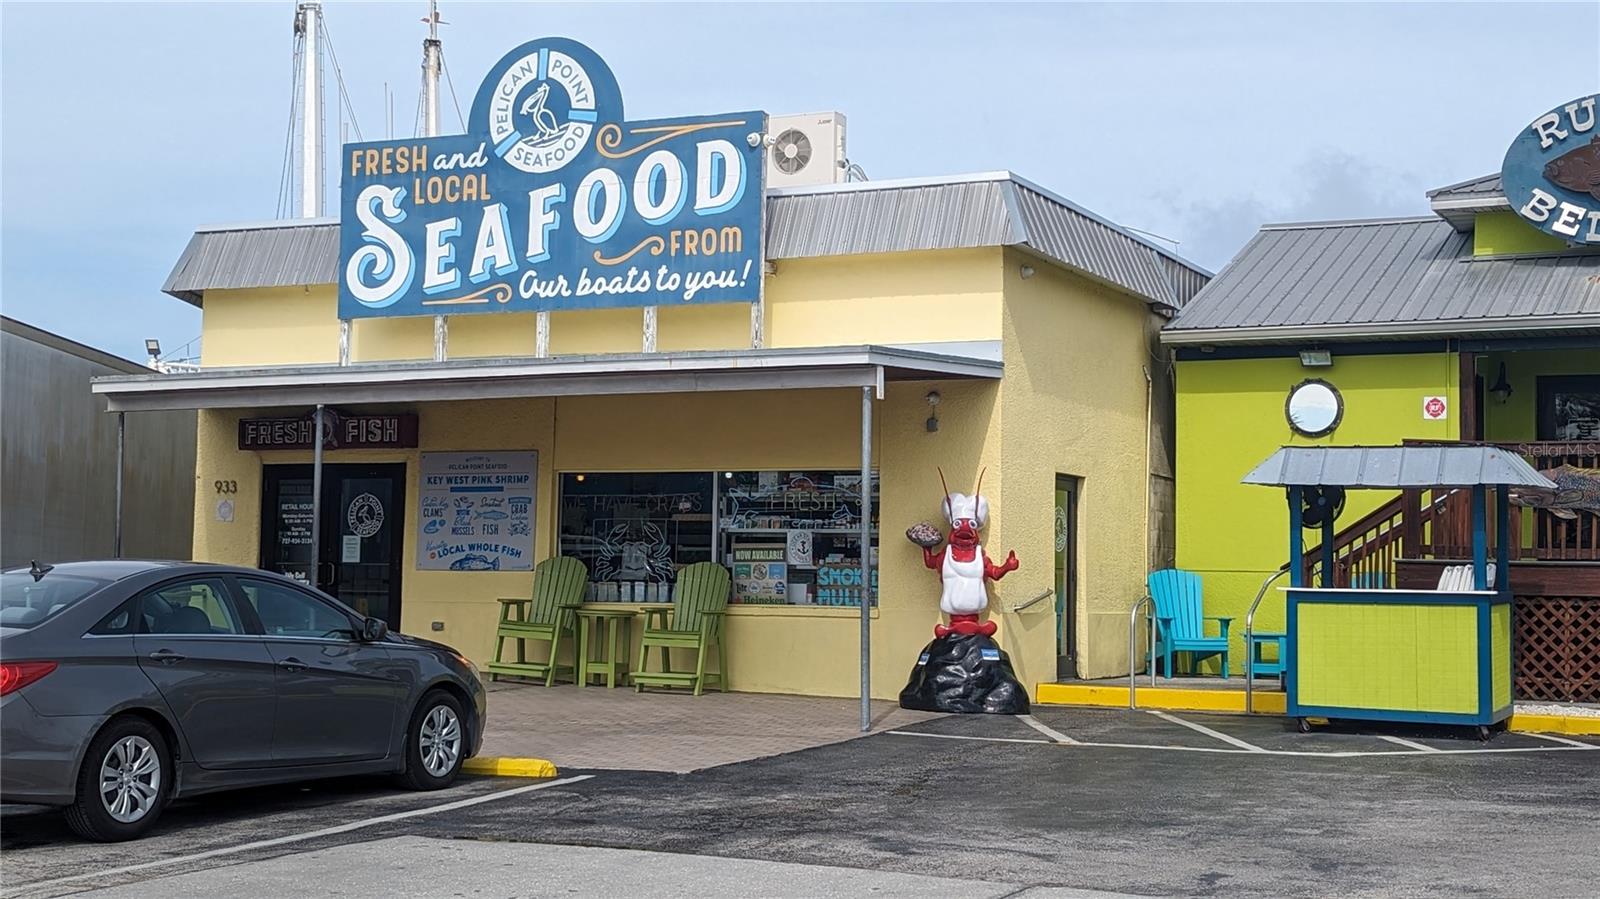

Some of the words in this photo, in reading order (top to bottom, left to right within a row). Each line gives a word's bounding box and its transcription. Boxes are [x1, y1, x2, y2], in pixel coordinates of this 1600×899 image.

[496, 61, 533, 135] PELICAN
[551, 59, 589, 104] POINT
[514, 126, 584, 167] SEAFOOD
[351, 145, 427, 177] FRESH
[434, 142, 488, 172] and
[414, 174, 491, 205] LOCAL
[346, 138, 747, 307] SEAFOOD
[670, 226, 742, 256] FROM
[519, 270, 572, 300] Our
[575, 265, 651, 298] boats
[655, 264, 679, 289] to
[682, 260, 752, 301] you!
[246, 421, 312, 444] FRESH
[346, 419, 398, 443] FISH
[214, 480, 239, 494] 933
[427, 476, 443, 485] KEY
[446, 476, 469, 484] WEST
[472, 475, 492, 484] PINK
[495, 474, 529, 484] SHRIMP
[511, 504, 528, 514] CRAB
[770, 491, 836, 511] FRESH
[423, 508, 443, 517] CLAMS
[451, 527, 474, 535] MUSSELS
[482, 524, 499, 535] FISH
[437, 545, 465, 558] LOCAL
[468, 543, 499, 553] WHOLE
[501, 545, 522, 558] FISH
[735, 550, 751, 560] NOW
[752, 550, 783, 560] AVAILABLE
[744, 596, 785, 605] Heineken
